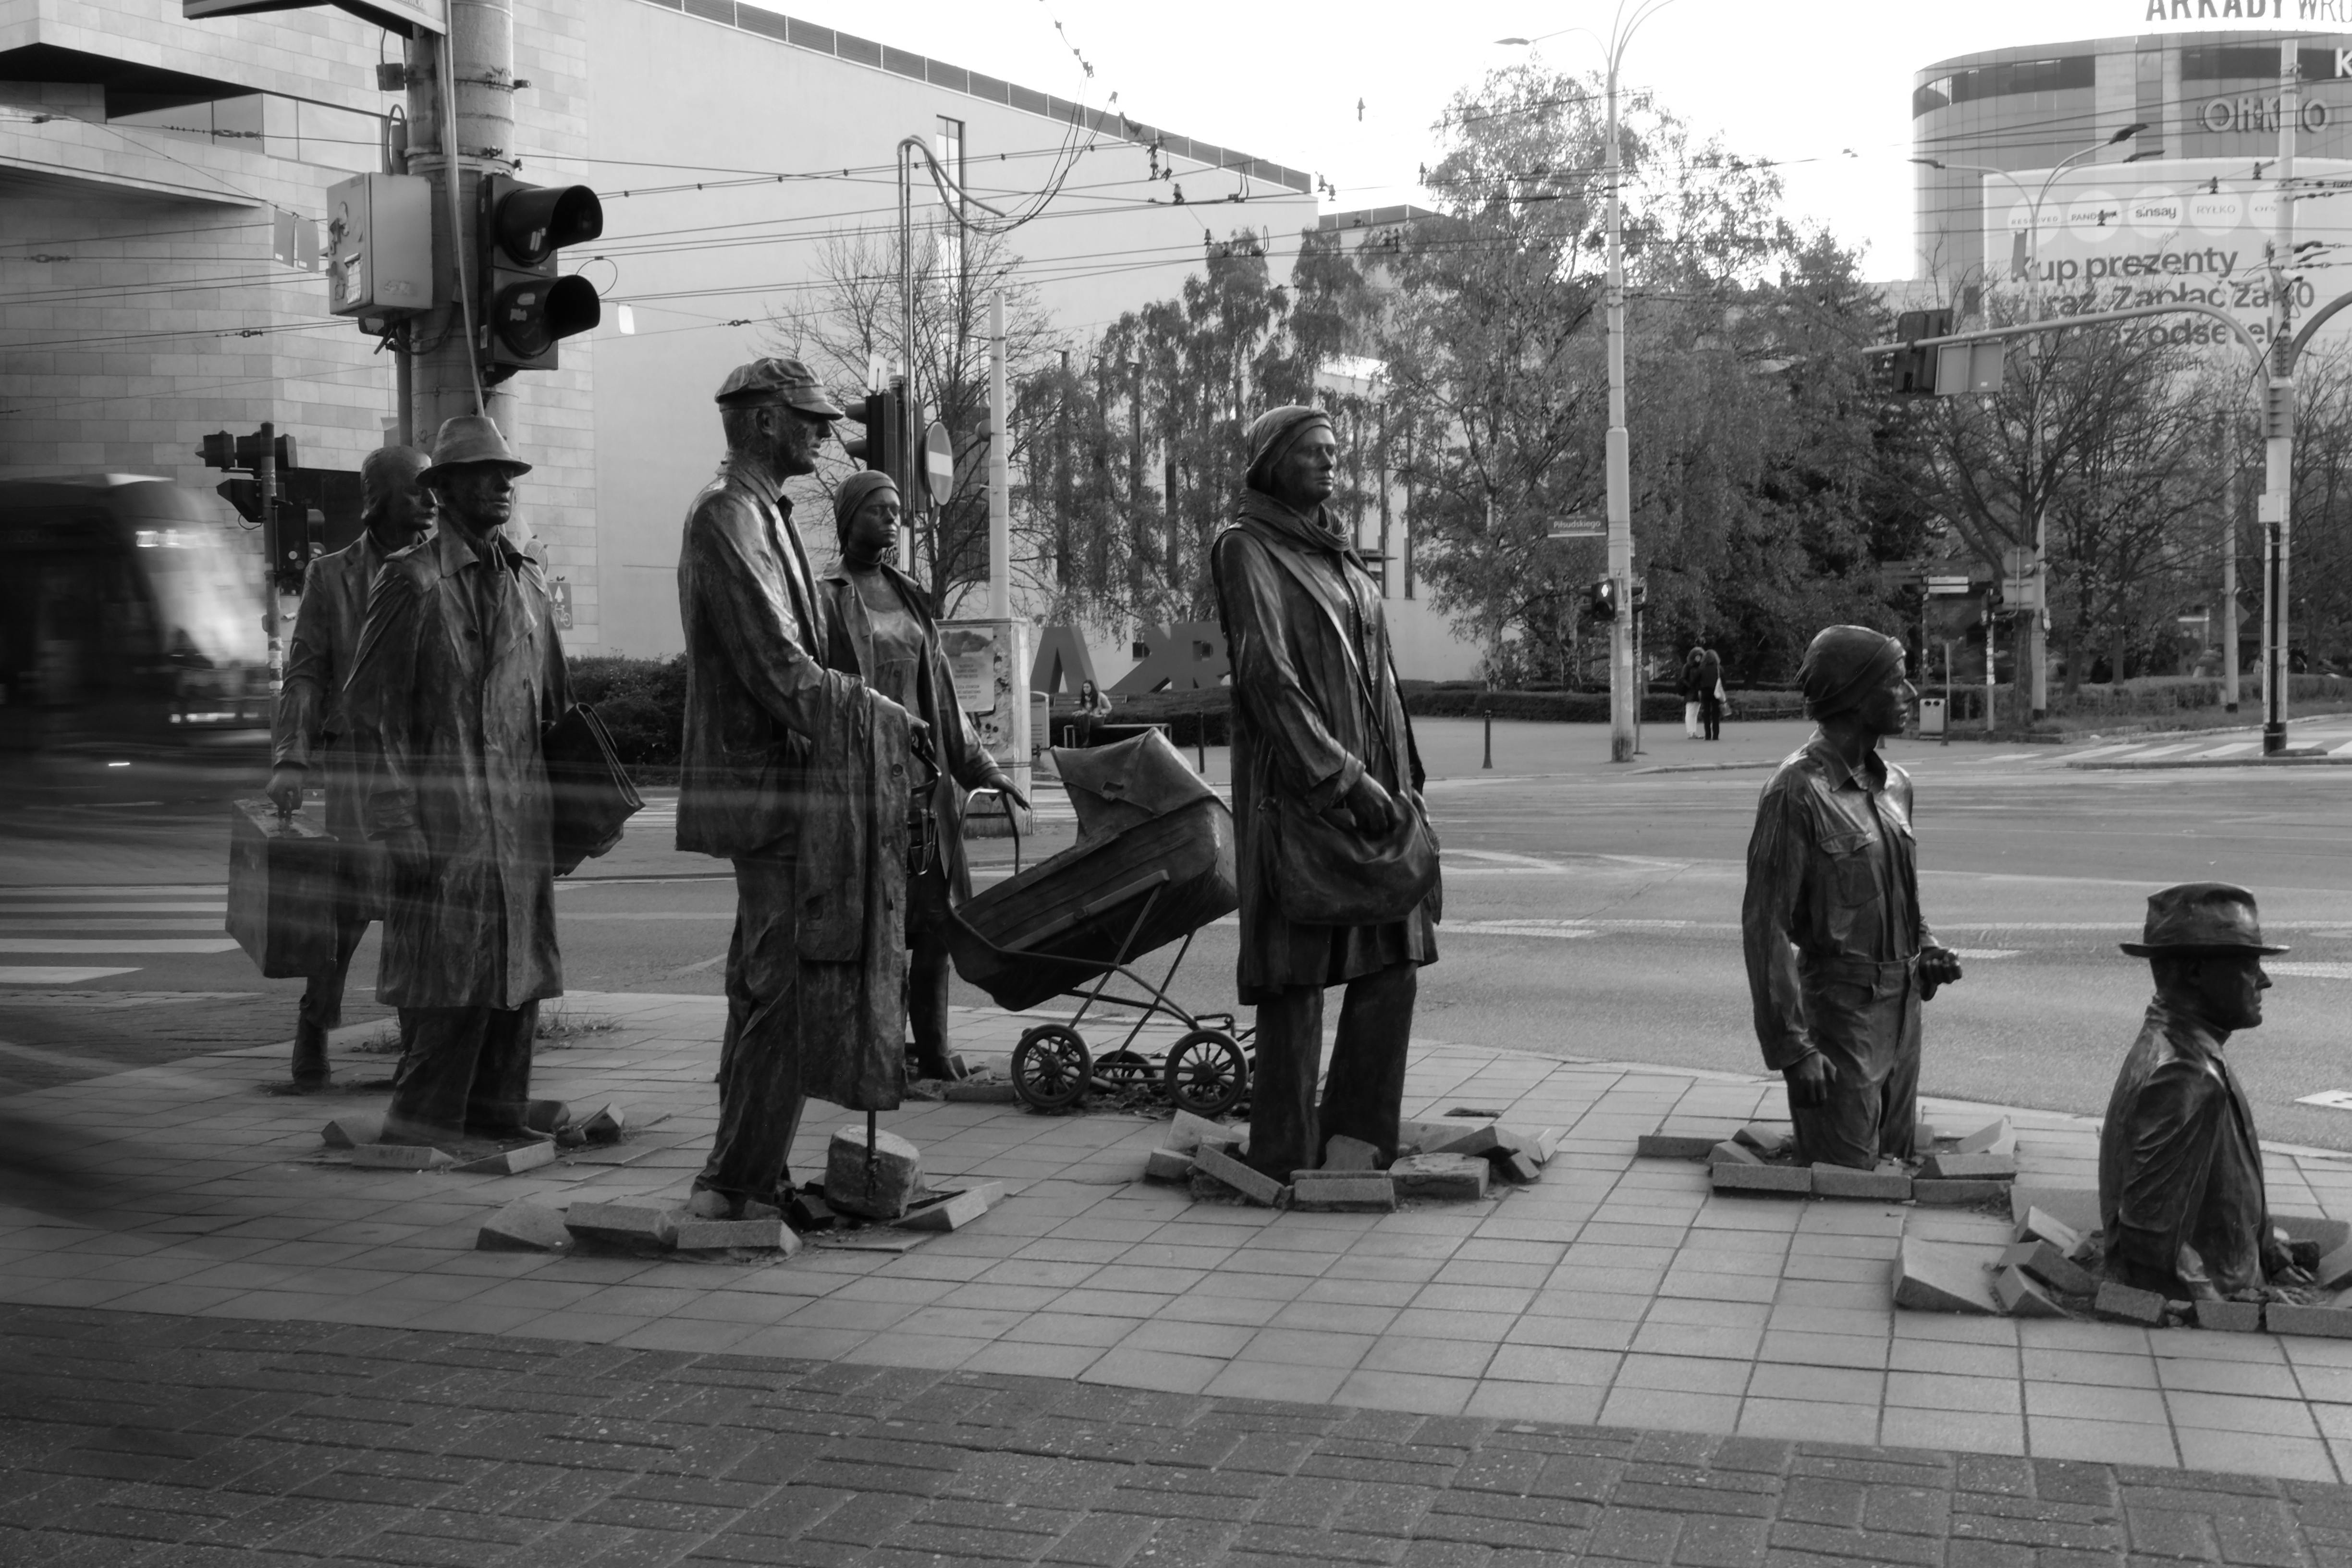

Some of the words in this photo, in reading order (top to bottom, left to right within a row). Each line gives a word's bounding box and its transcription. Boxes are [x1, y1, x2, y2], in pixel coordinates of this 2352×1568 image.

[2145, 0, 2282, 21] ARKADY
[2196, 204, 2236, 215] RYŁKO
[2011, 216, 2058, 225] RESVED
[2071, 211, 2118, 221] PAND
[2086, 246, 2238, 286] prezenty
[2148, 316, 2273, 346] odsee
[1553, 519, 1601, 529] Piłsudskiego
